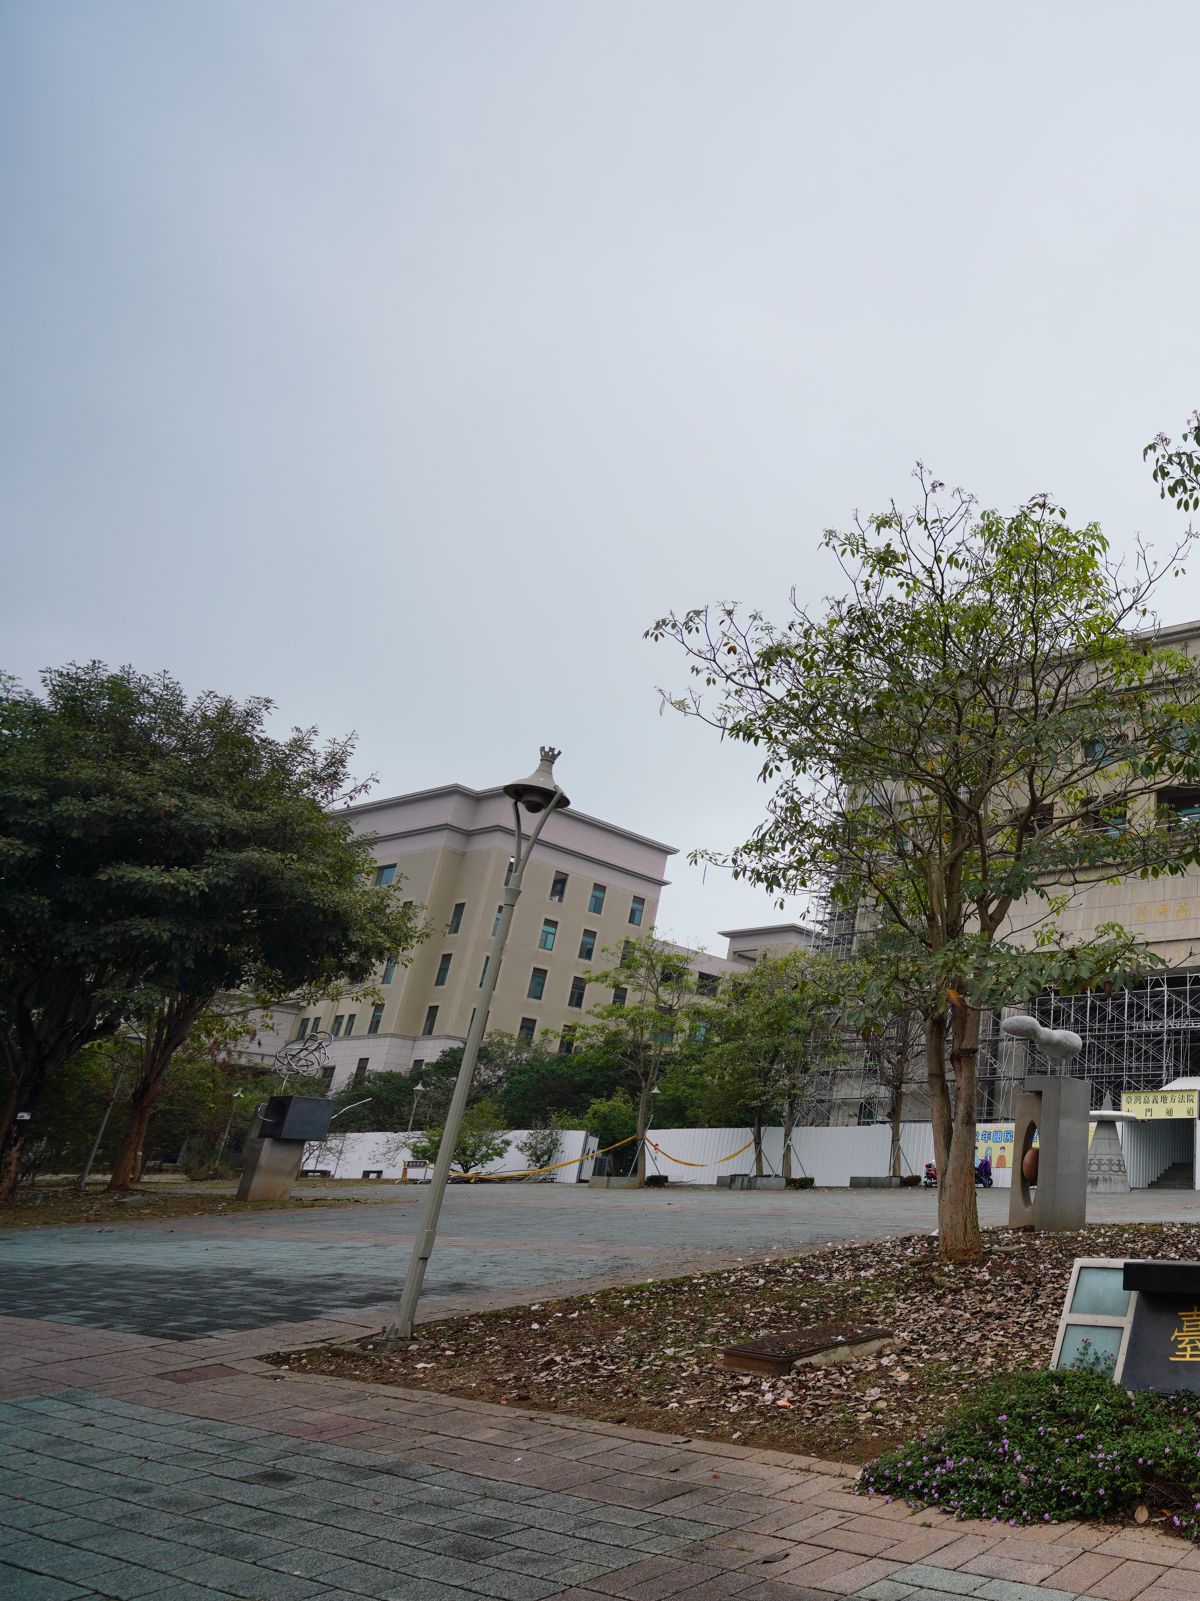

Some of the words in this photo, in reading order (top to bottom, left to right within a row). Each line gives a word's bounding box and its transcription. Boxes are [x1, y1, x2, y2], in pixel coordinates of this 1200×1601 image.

[1125, 1094, 1195, 1105] 臺灣嘉義地方法院
